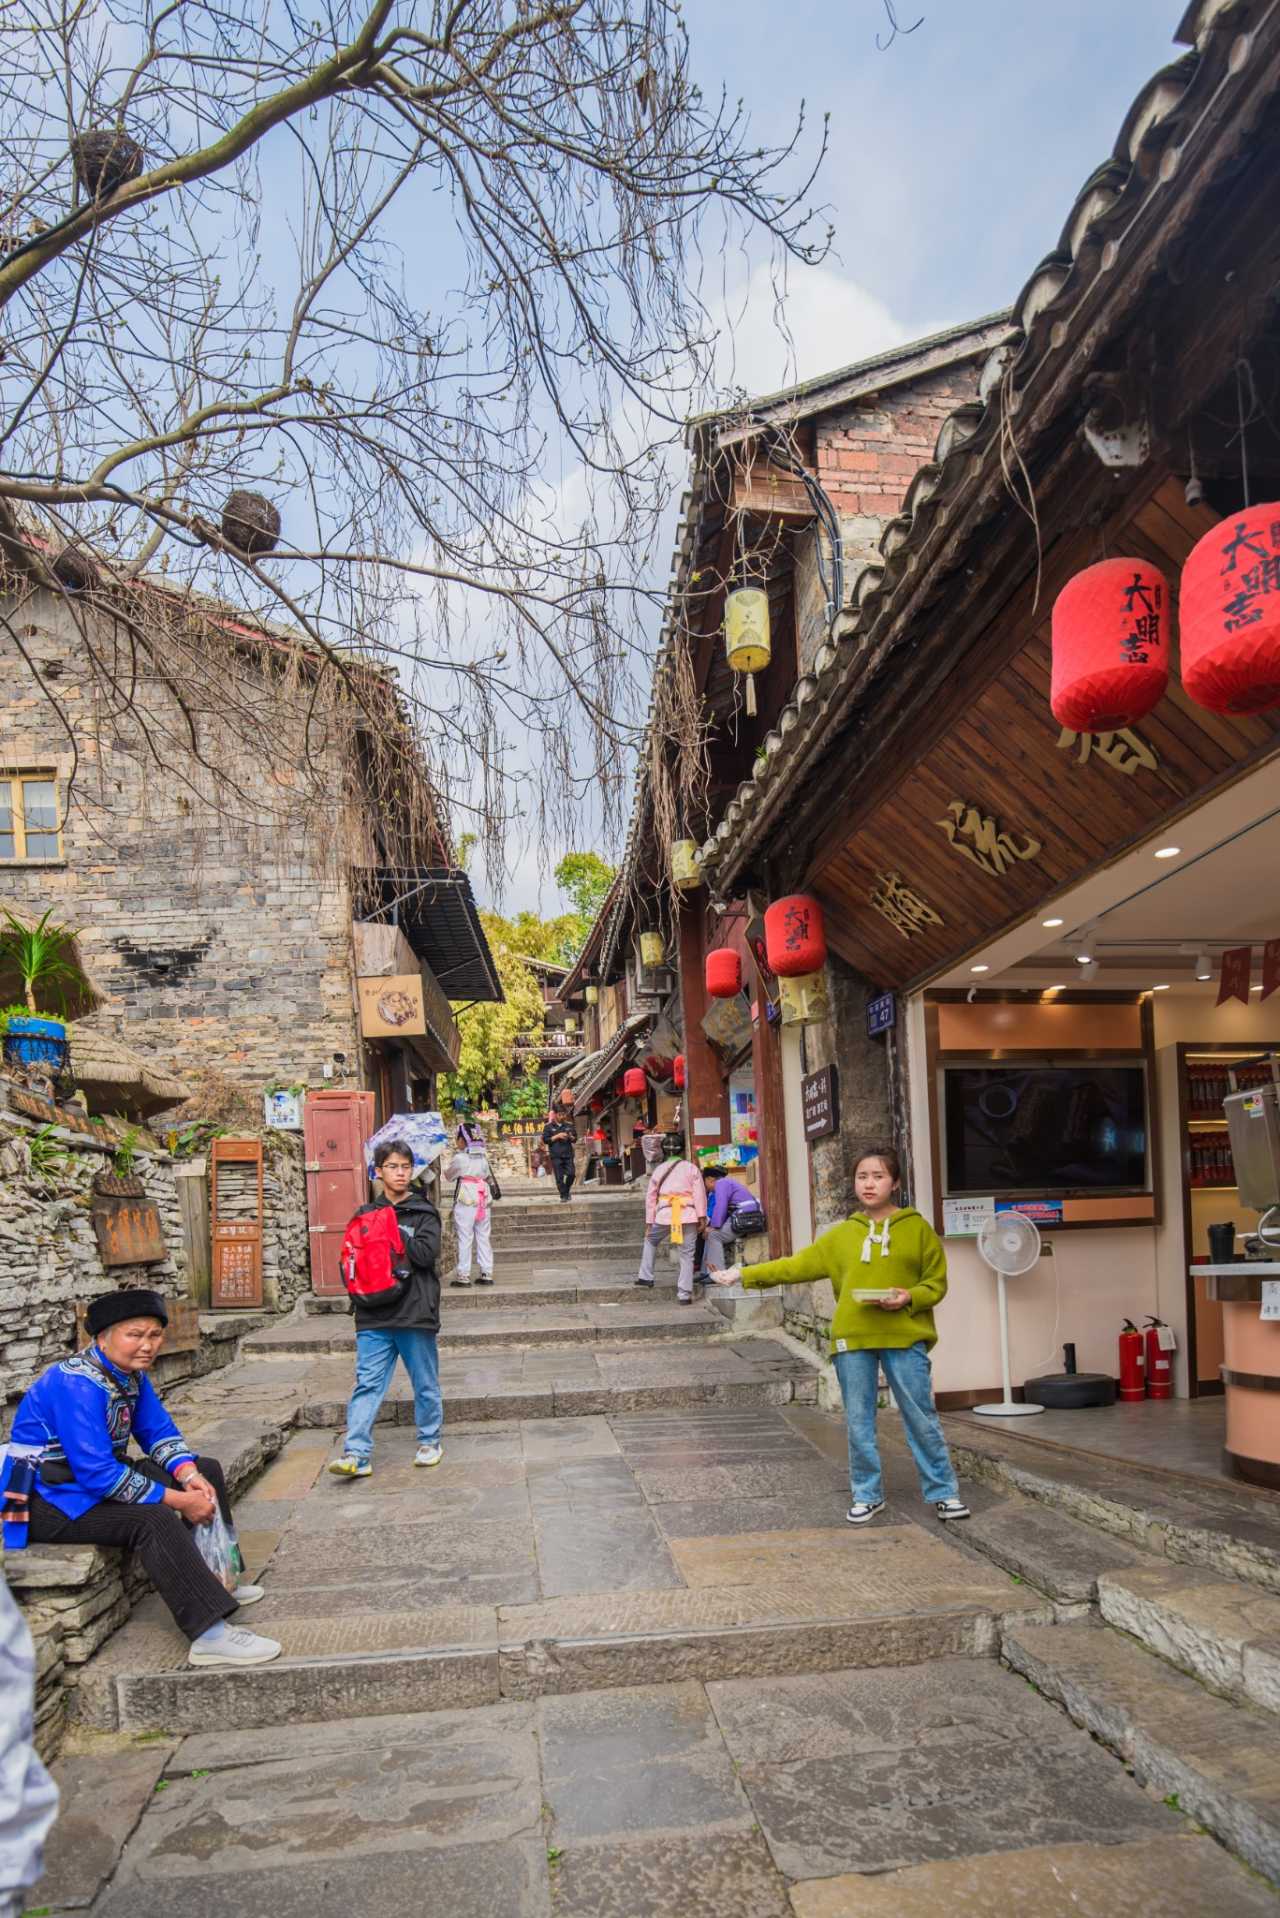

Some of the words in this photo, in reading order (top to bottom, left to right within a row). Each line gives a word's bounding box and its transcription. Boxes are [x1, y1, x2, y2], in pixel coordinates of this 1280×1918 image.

[1120, 573, 1160, 664] 大明志
[1220, 522, 1280, 633] 大明志
[880, 1007, 889, 1024] 47
